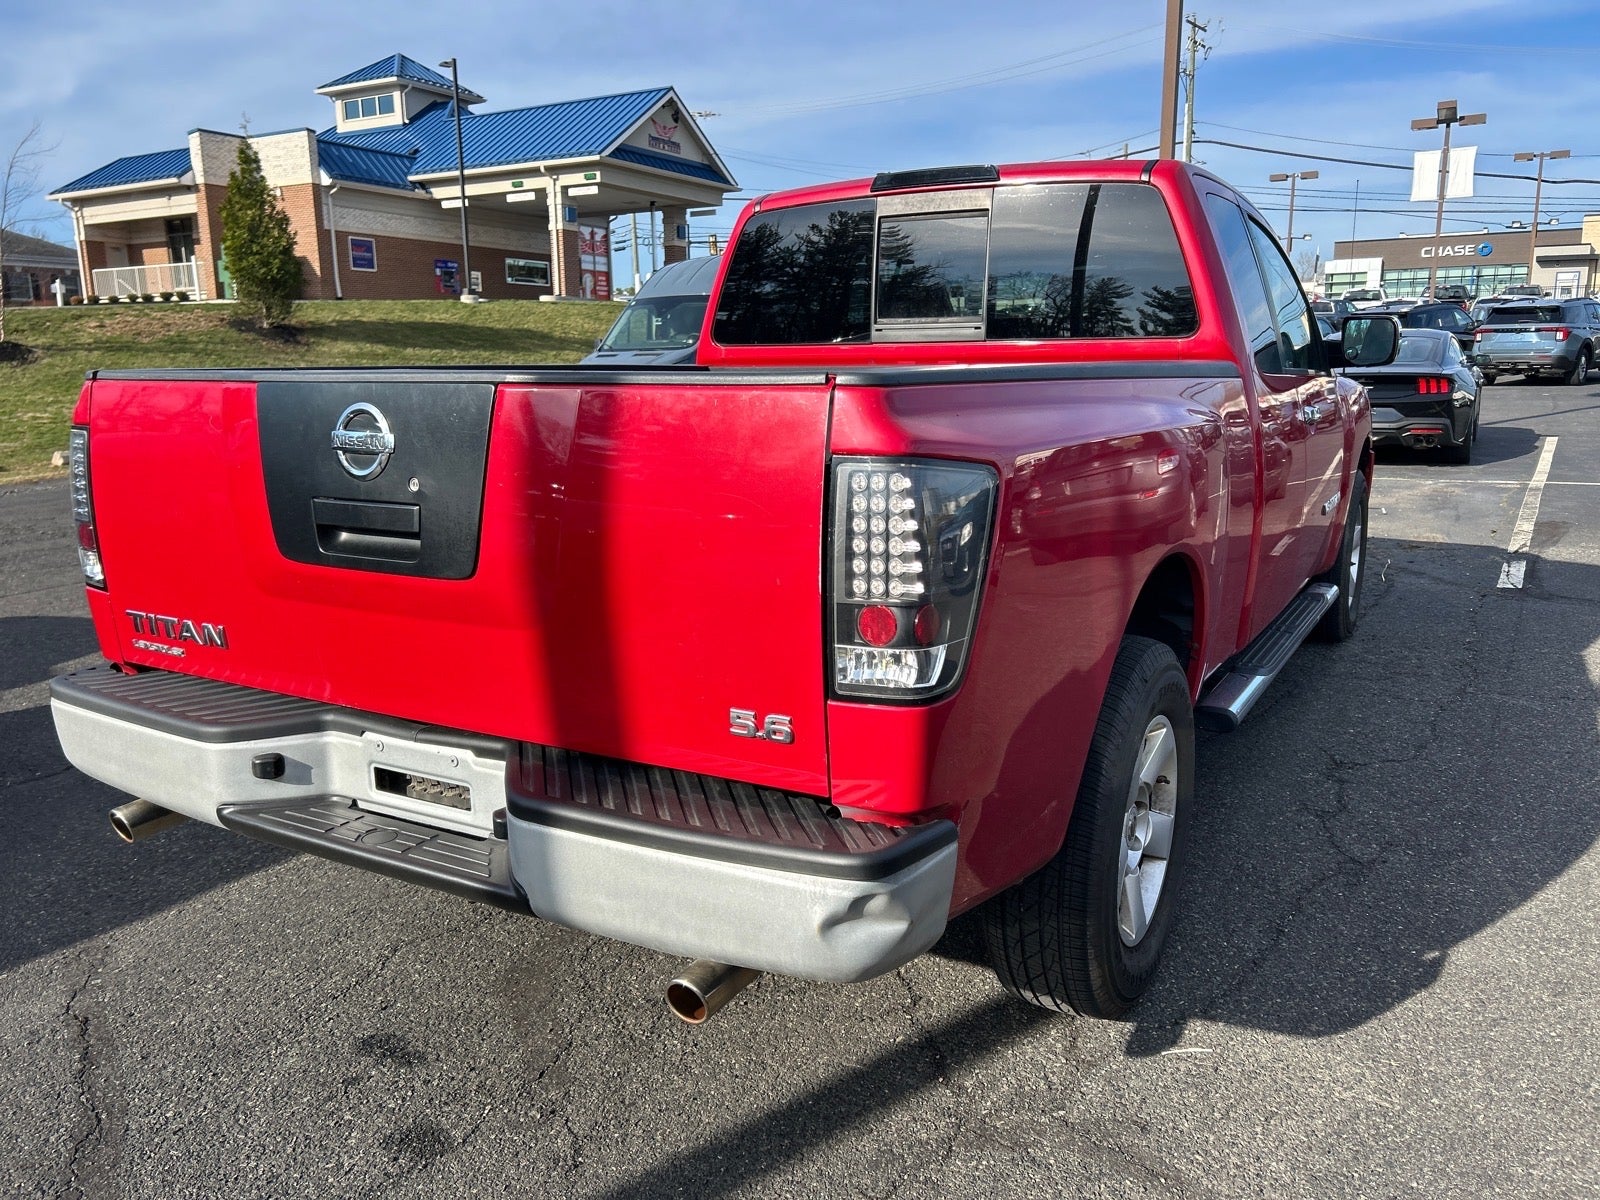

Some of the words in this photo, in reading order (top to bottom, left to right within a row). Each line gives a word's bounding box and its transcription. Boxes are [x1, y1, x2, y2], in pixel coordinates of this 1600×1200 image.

[1421, 244, 1476, 258] CHASE
[334, 434, 385, 450] NISSAN
[125, 609, 229, 649] TITAN
[729, 707, 794, 744] 5.6
